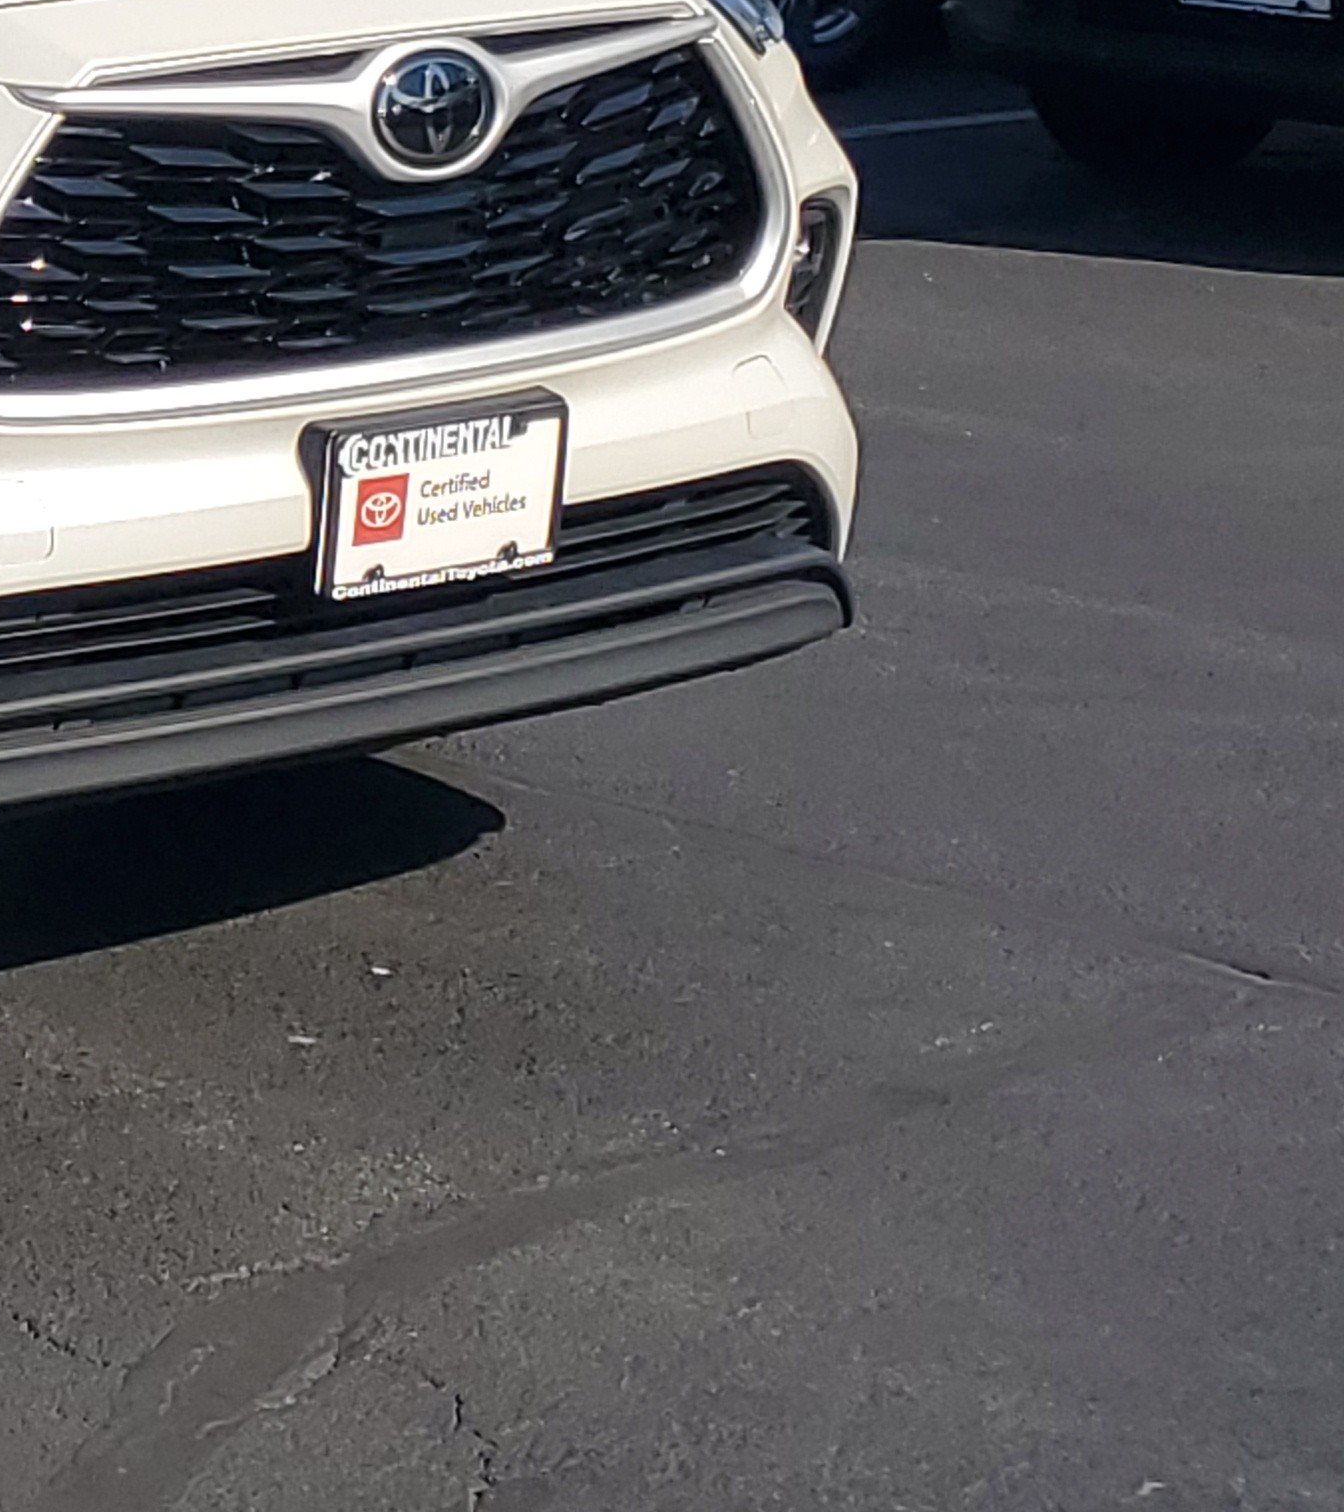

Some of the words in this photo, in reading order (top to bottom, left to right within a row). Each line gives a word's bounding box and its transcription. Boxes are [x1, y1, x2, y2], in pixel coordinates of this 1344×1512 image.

[339, 416, 513, 477] CONTINENTAL
[421, 469, 490, 498] Certified
[417, 502, 459, 525] Used
[463, 493, 527, 519] Vehicles
[331, 551, 554, 601] ContinentalToyota.com
